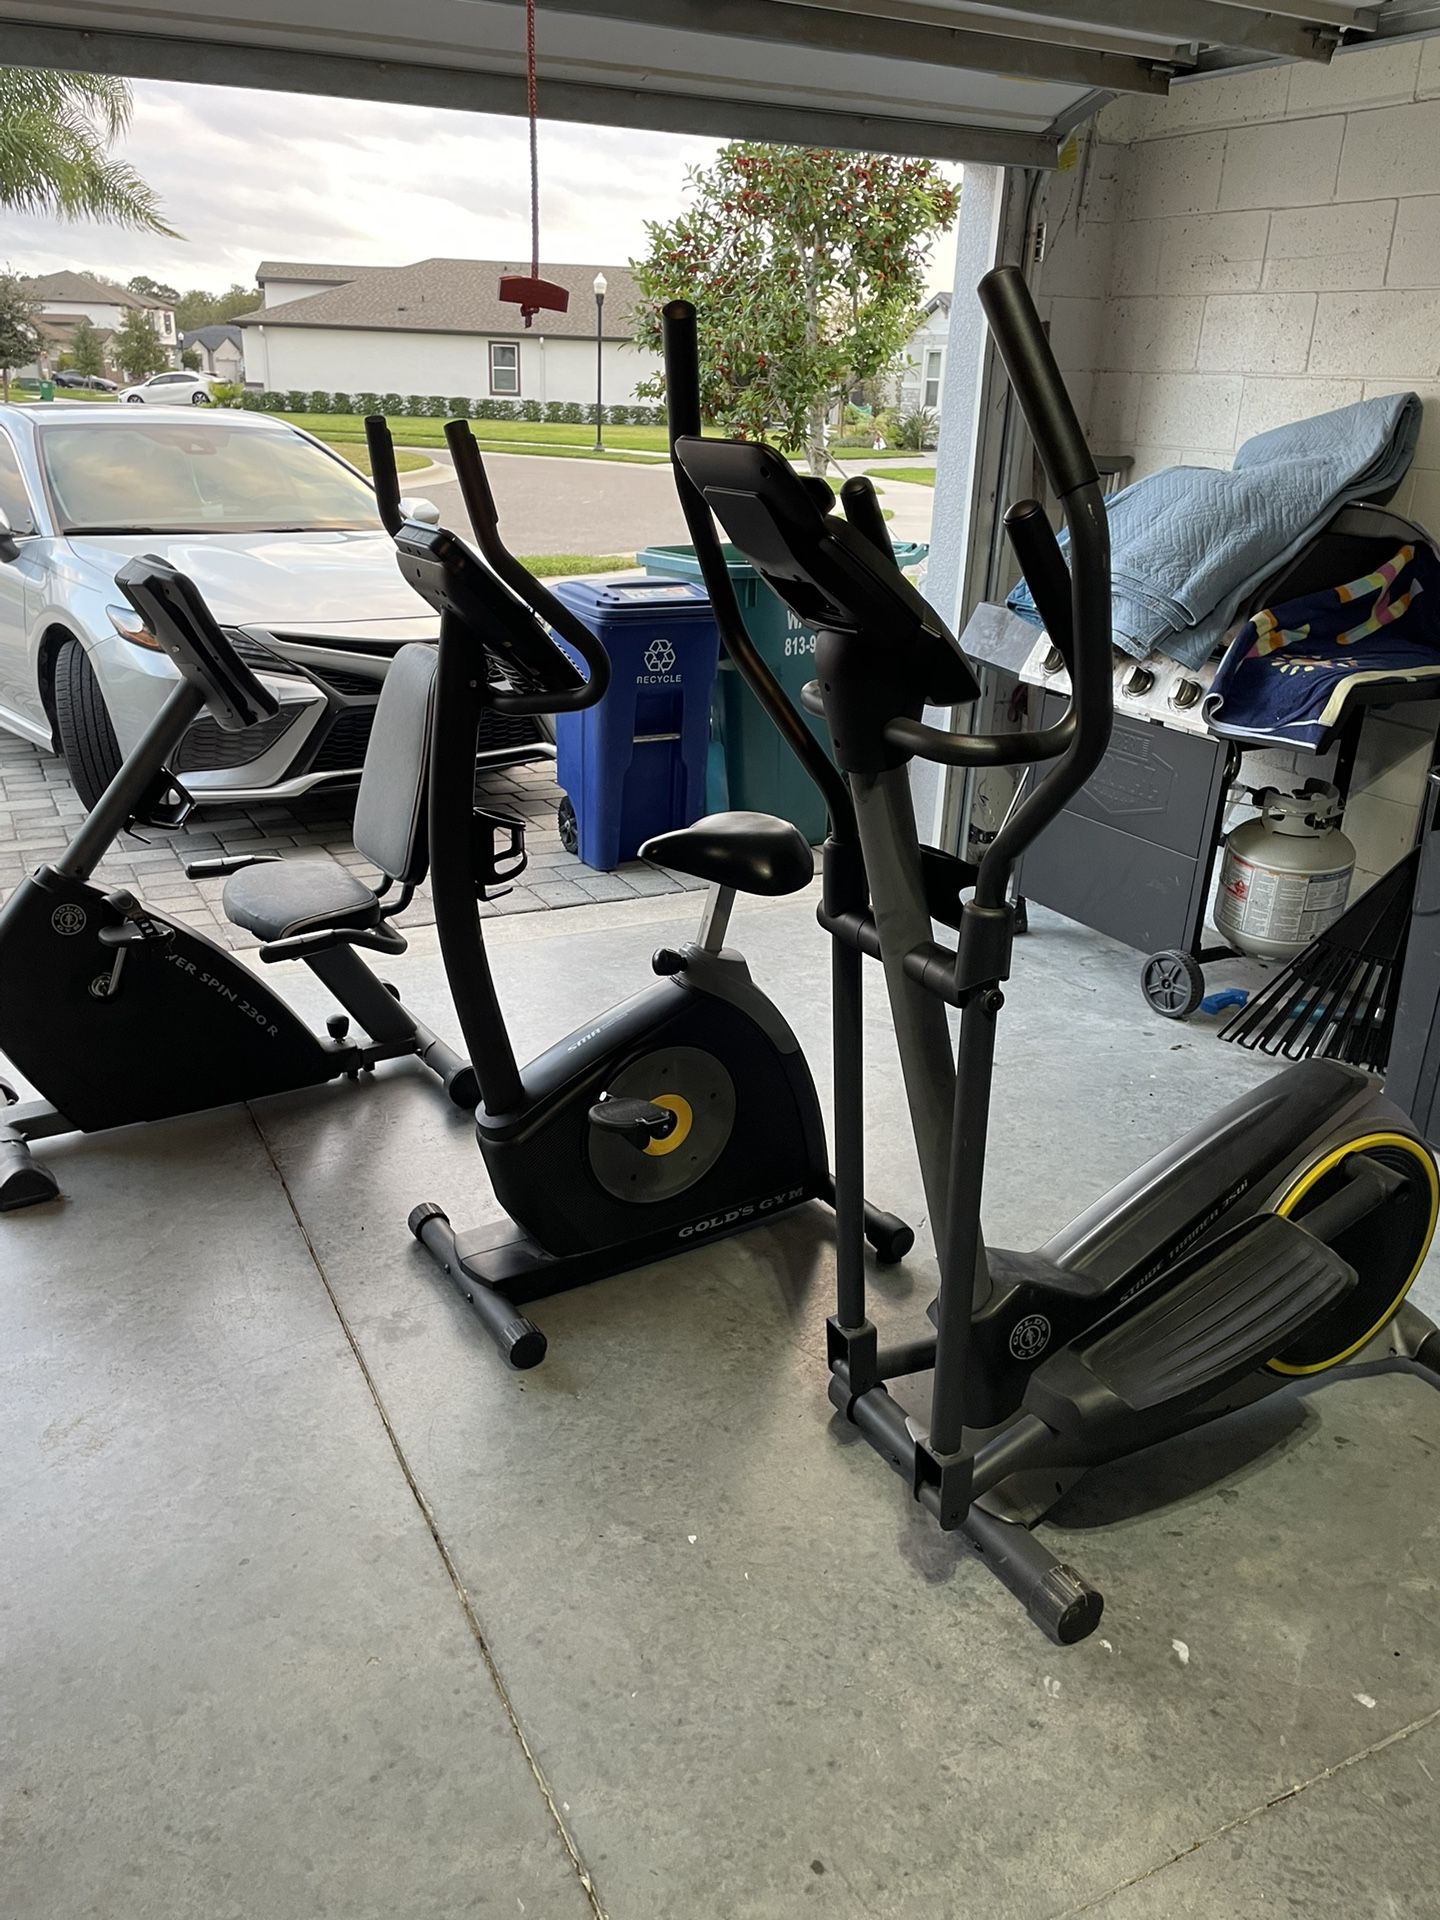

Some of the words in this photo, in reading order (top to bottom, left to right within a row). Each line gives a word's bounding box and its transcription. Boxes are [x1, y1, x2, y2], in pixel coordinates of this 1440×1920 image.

[636, 674, 683, 684] RECYCLE
[200, 972, 238, 1002] SPIN
[238, 1000, 267, 1025] 230
[267, 1025, 278, 1037] R
[678, 1205, 754, 1238] GOLD'S
[759, 1187, 804, 1210] GYM
